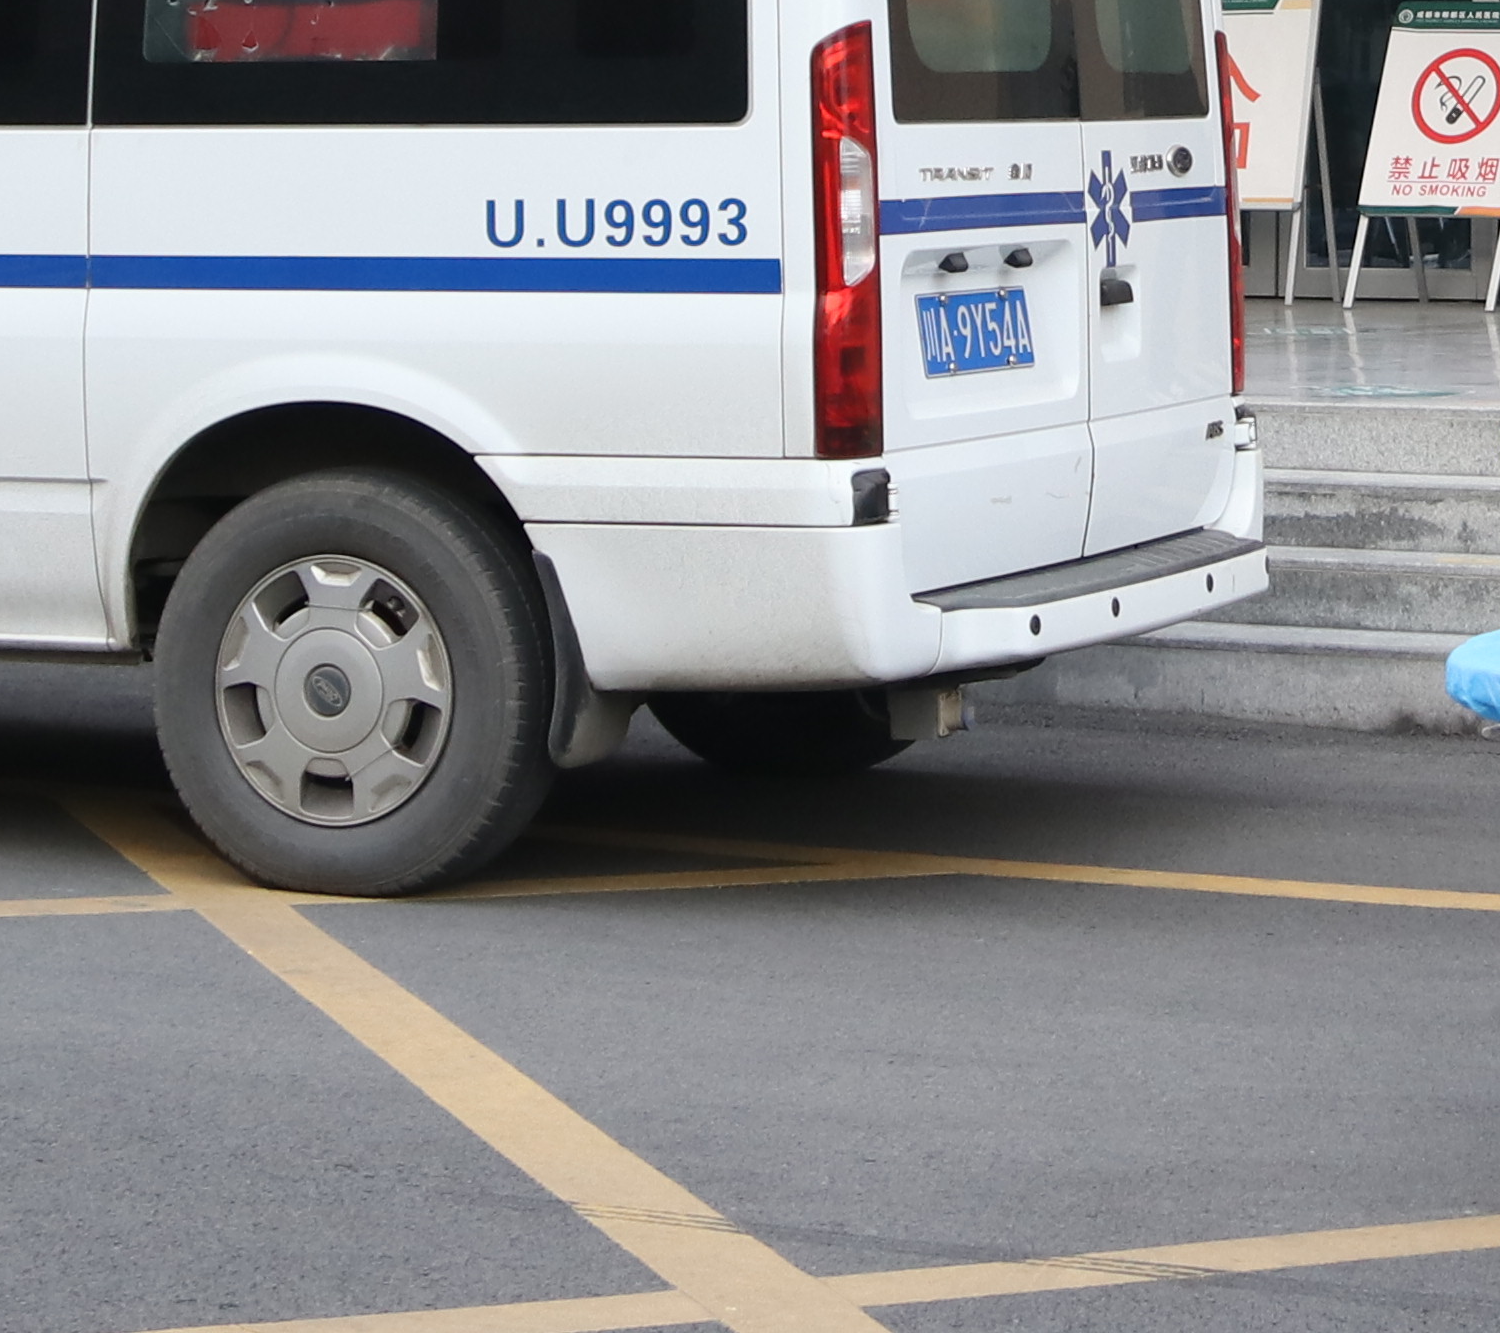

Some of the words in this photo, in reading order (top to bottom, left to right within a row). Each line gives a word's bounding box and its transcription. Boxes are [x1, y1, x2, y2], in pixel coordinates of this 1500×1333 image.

[1388, 155, 1500, 182] 禁止吸烟
[1391, 184, 1413, 196] NO
[1418, 184, 1487, 197] SMOKING
[485, 197, 748, 248] U.U9993
